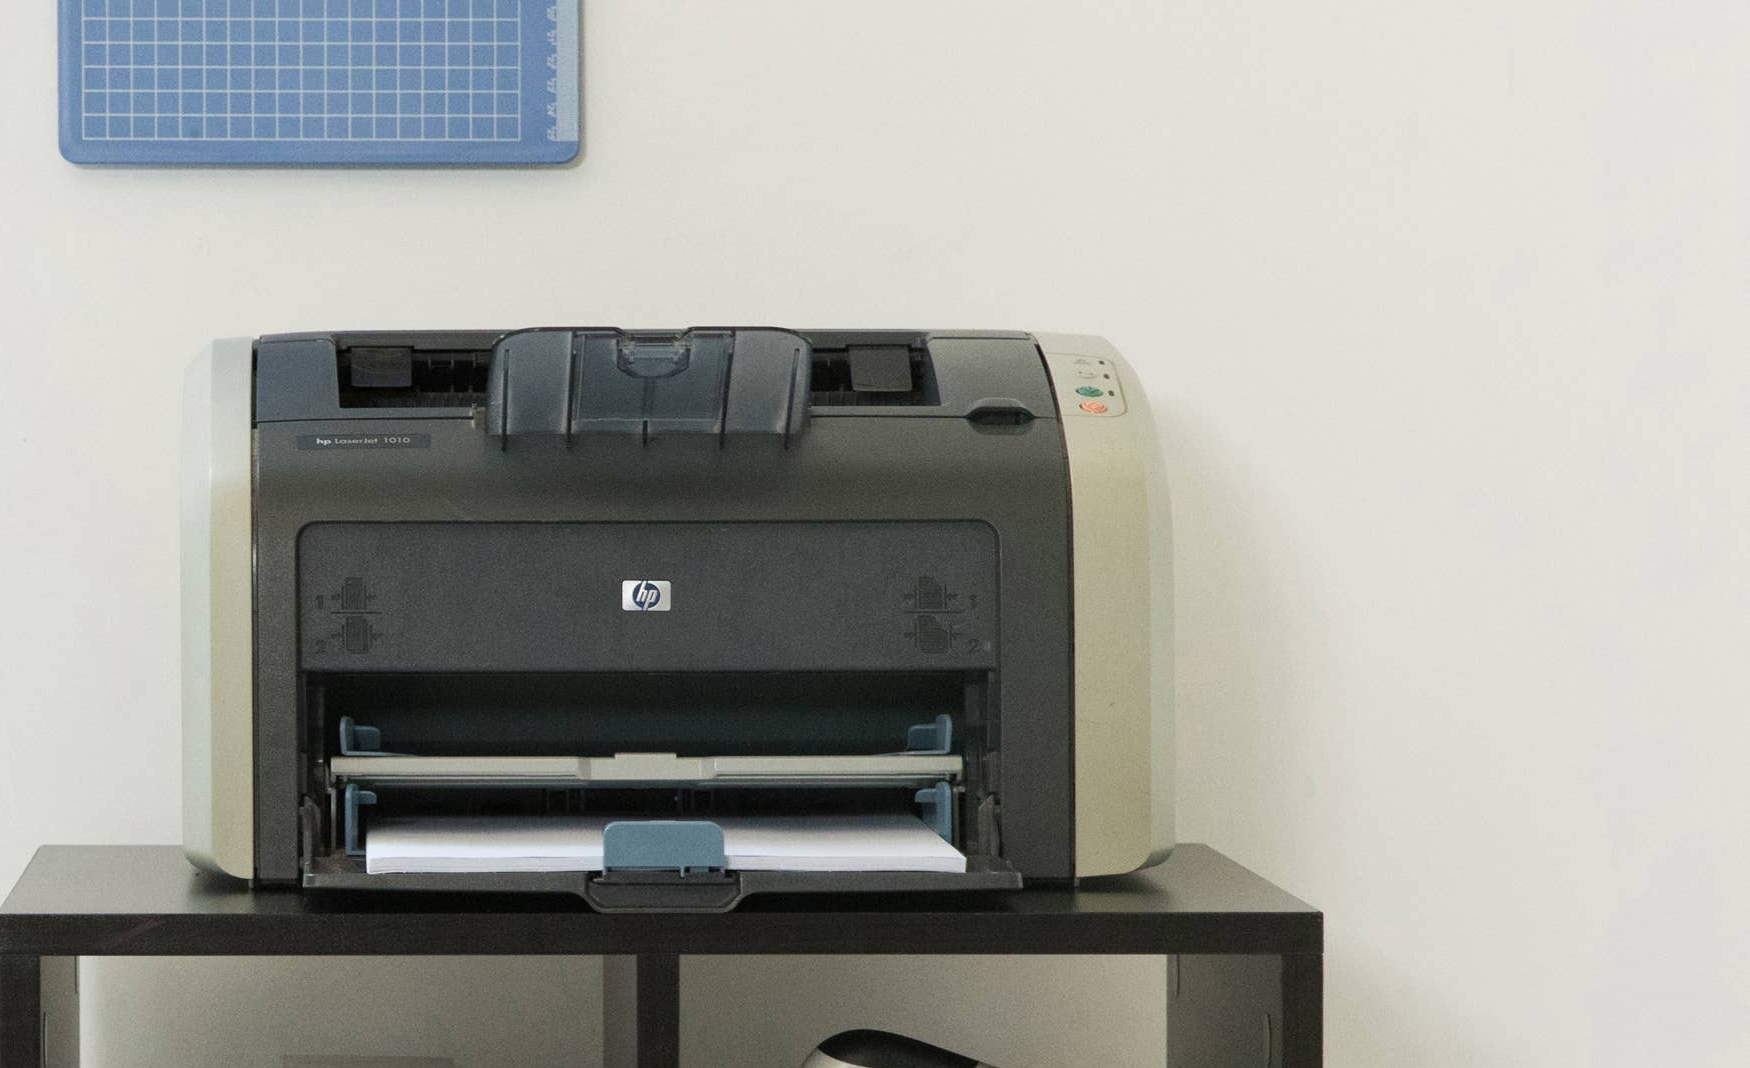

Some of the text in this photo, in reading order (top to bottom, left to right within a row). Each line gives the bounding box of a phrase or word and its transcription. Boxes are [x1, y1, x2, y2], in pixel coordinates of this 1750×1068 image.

[316, 437, 332, 446] hp
[315, 594, 324, 609] 1
[636, 580, 657, 611] hp
[314, 639, 327, 654] 2
